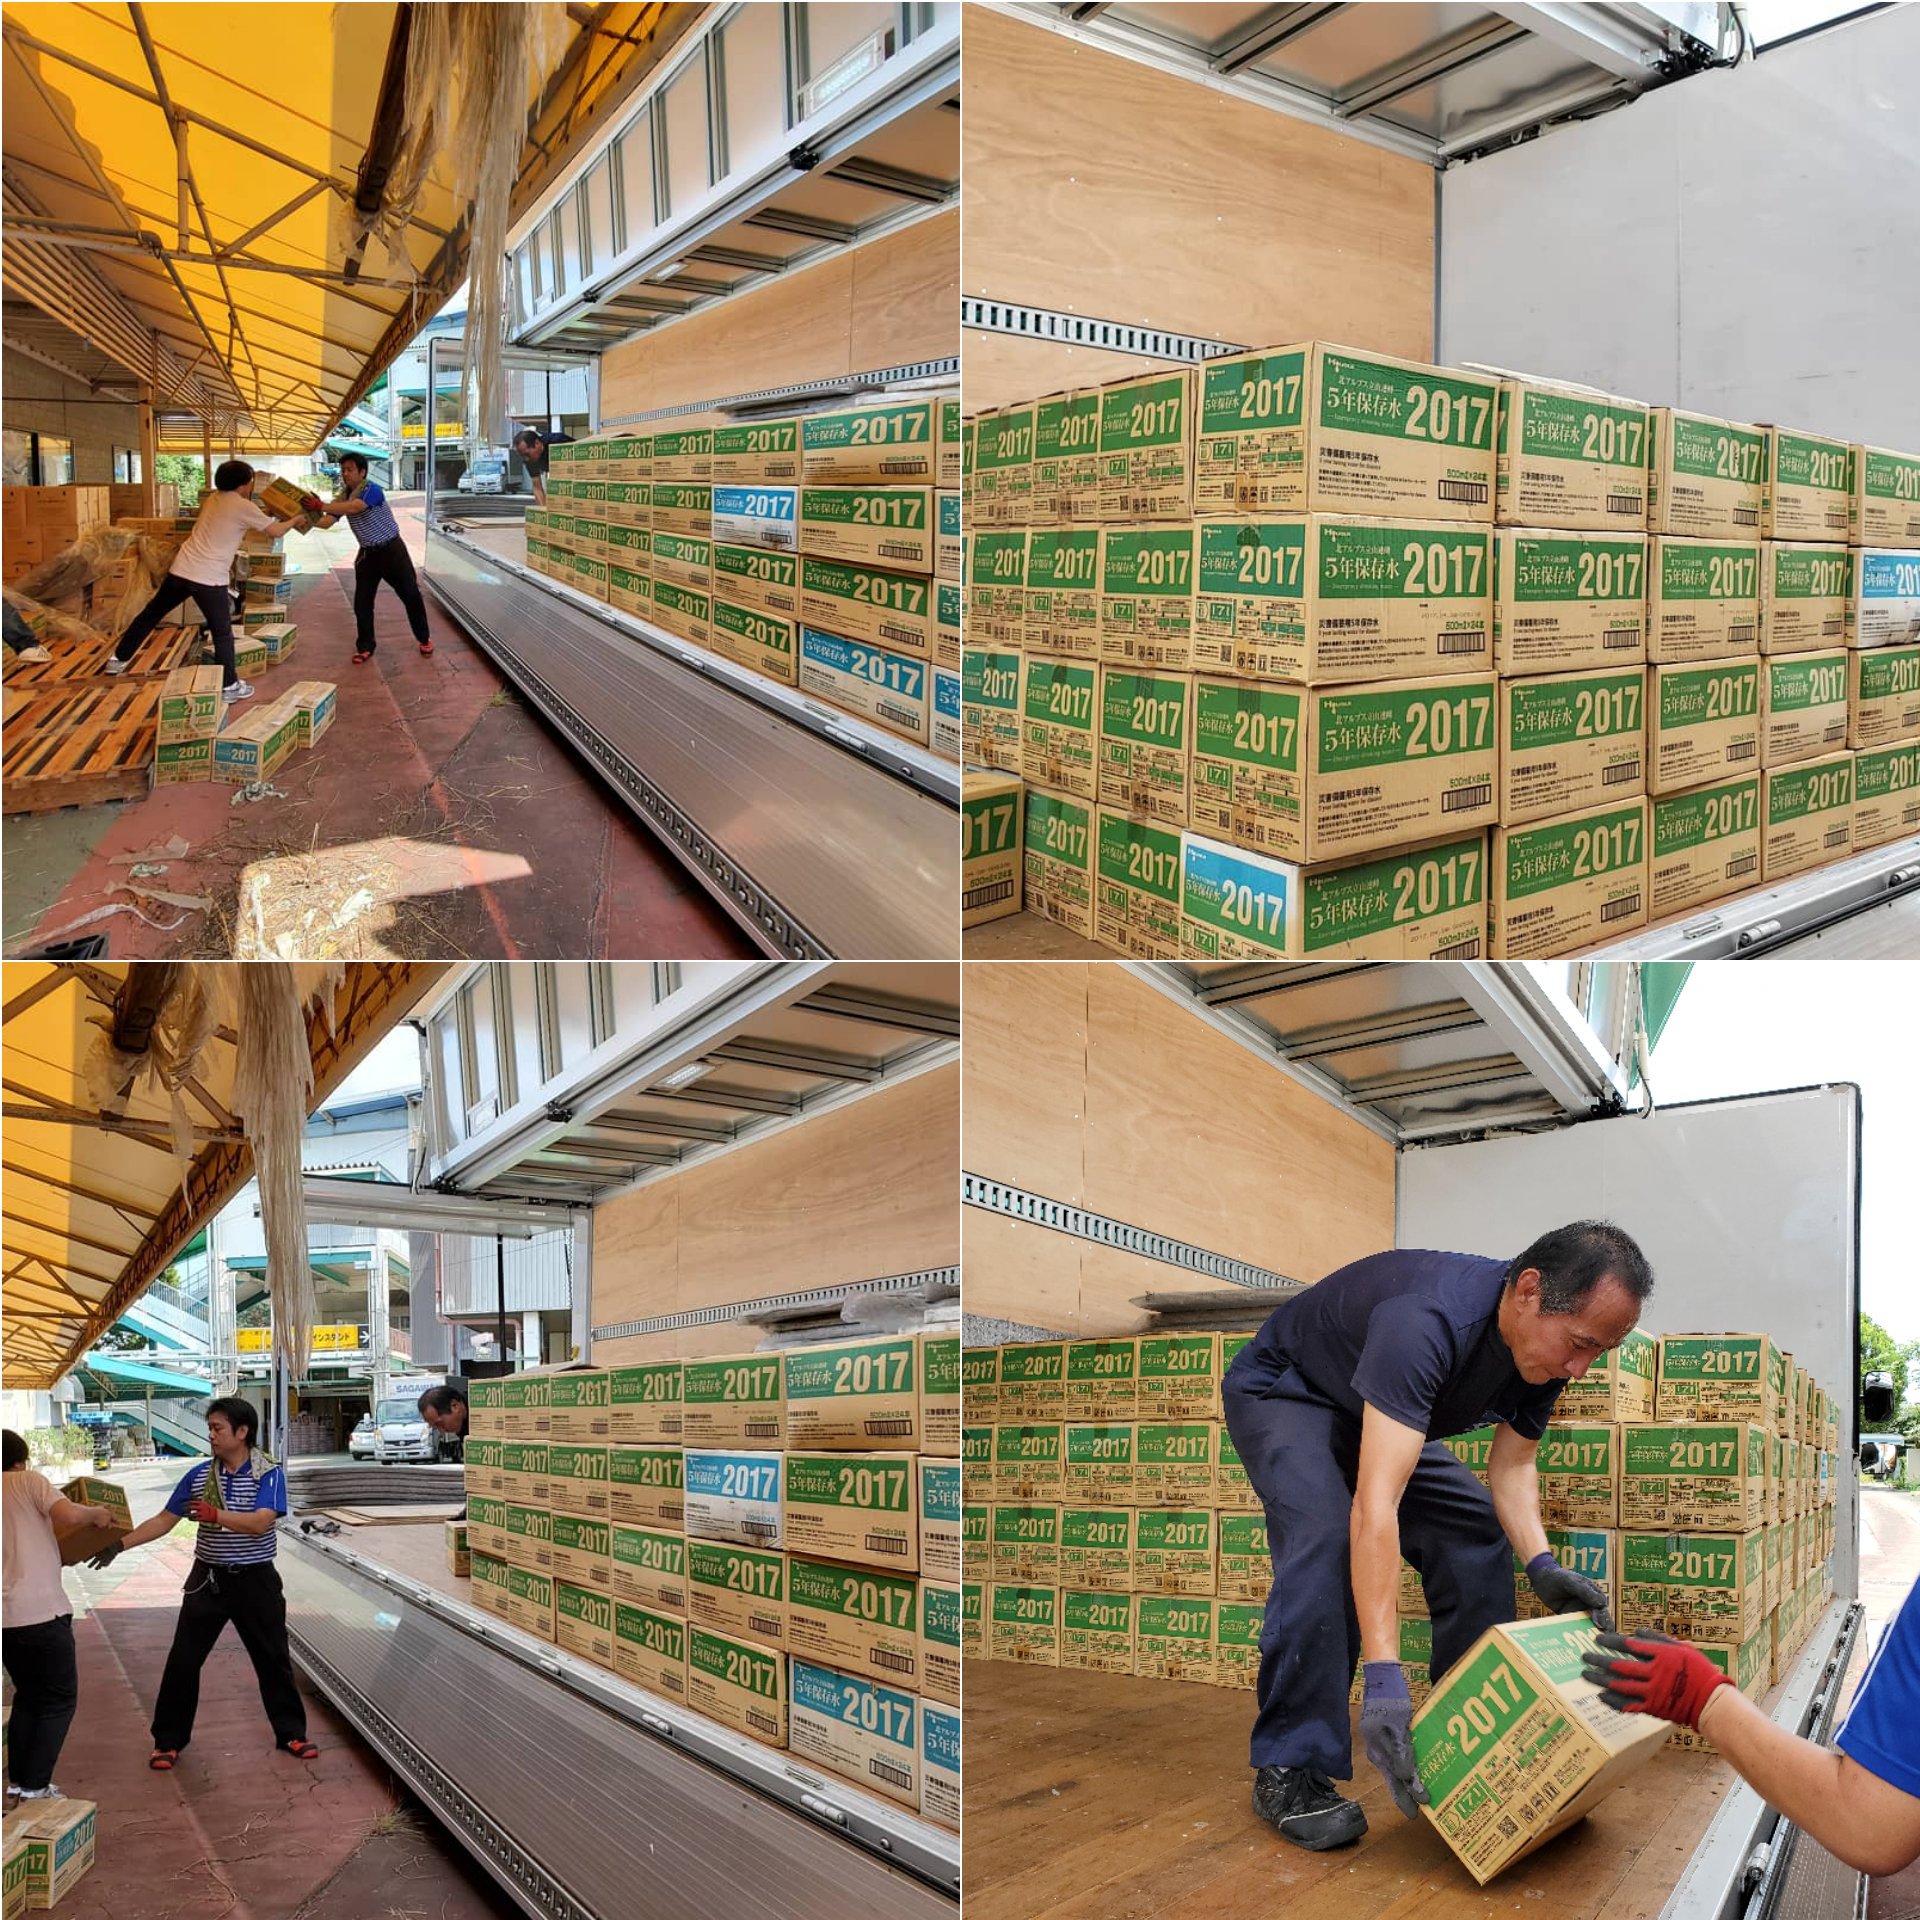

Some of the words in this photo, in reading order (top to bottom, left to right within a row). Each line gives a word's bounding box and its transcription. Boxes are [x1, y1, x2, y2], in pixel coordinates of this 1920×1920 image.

[1240, 375, 1300, 418] 2017
[1327, 387, 1401, 419] 5年保存水
[851, 412, 926, 444] 2017
[1130, 398, 1179, 437] 2017
[1404, 385, 1489, 445] 2017
[679, 435, 712, 453] 2017
[747, 428, 794, 451] 2017
[998, 428, 1031, 458] 2017
[1060, 414, 1098, 446] 2017
[1527, 420, 1580, 443] 5年保存水
[1583, 413, 1642, 463] 2017
[1717, 437, 1761, 482] 2017
[1810, 450, 1845, 488] 2017
[587, 486, 605, 499] 2017
[625, 488, 649, 503] 2017
[677, 490, 710, 508] 2017
[745, 494, 791, 518] 2017
[853, 497, 921, 527] 2017
[588, 521, 605, 536] 2017
[627, 529, 649, 550] 2017
[676, 542, 708, 564] 2017
[1054, 548, 1096, 579] 2017
[1137, 550, 1190, 584] 2017
[1239, 546, 1302, 585] 2017
[588, 561, 605, 580] 2017
[747, 556, 794, 584] 2017
[1325, 557, 1399, 579] 5年保存水
[1403, 543, 1484, 595] 2017
[1520, 565, 1575, 585] 5年保存水
[1578, 552, 1641, 597] 2017
[1710, 556, 1754, 596] 2017
[1810, 560, 1844, 594] 2017
[627, 573, 649, 595] 2017
[853, 574, 924, 613] 2017
[677, 593, 708, 619] 2017
[744, 617, 789, 649] 2017
[240, 650, 264, 664] 2017
[851, 649, 920, 695] 2017
[983, 668, 1016, 700] 2017
[1809, 665, 1845, 703] 2017
[1891, 658, 1919, 692] 2017
[1050, 682, 1091, 719] 2017
[1576, 685, 1639, 736] 2017
[1706, 675, 1755, 717] 2017
[1132, 696, 1182, 737] 2017
[1405, 696, 1490, 755] 2017
[1515, 707, 1572, 732] 5年保存水
[1234, 710, 1295, 758] 2017
[1325, 722, 1401, 751] 5年保存水
[179, 743, 208, 758] 2017
[231, 749, 257, 762] 2017
[1209, 766, 1227, 782] 171
[1807, 770, 1849, 811] 2017
[1704, 788, 1756, 839] 2017
[1046, 816, 1086, 857] 2017
[1573, 818, 1639, 877] 2017
[1129, 843, 1177, 890] 2017
[1512, 850, 1570, 881] 5年保存水
[1393, 851, 1478, 922] 2017
[1220, 880, 1282, 936] 2017
[1310, 890, 1388, 929] 5年保存水
[1195, 931, 1213, 948] 171
[835, 1352, 908, 1392] 2017
[963, 1360, 995, 1379] 2017
[1025, 1356, 1062, 1376] 2017
[1094, 1353, 1132, 1373] 2017
[1168, 1349, 1210, 1370] 2017
[1702, 1352, 1757, 1372] 2017
[524, 1384, 549, 1405] 2017
[577, 1381, 609, 1405] 2017
[643, 1372, 682, 1400] 2017
[723, 1366, 776, 1400] 2017
[522, 1450, 548, 1472] 2017
[1021, 1437, 1057, 1456] 2017
[1092, 1438, 1129, 1457] 2017
[1166, 1437, 1208, 1457] 2017
[1549, 1442, 1606, 1467] 2017
[1670, 1442, 1734, 1467] 2017
[574, 1453, 606, 1477] 2017
[641, 1457, 682, 1484] 2017
[721, 1464, 776, 1498] 2017
[839, 1468, 906, 1508] 2017
[484, 1506, 504, 1527] 2017
[526, 1514, 549, 1538] 2017
[1019, 1518, 1055, 1537] 2017
[578, 1526, 609, 1553] 2017
[1087, 1523, 1127, 1543] 2017
[1165, 1523, 1207, 1545] 2017
[642, 1540, 682, 1571] 2017
[1668, 1552, 1733, 1580] 2017
[488, 1564, 507, 1586] 2017
[727, 1557, 780, 1598] 2017
[527, 1578, 550, 1606] 2017
[843, 1578, 912, 1626] 2017
[581, 1597, 609, 1627] 2017
[1017, 1598, 1053, 1619] 2017
[1089, 1605, 1128, 1626] 2017
[1167, 1611, 1209, 1634] 2017
[645, 1621, 681, 1657] 2017
[727, 1650, 775, 1695] 2017
[843, 1687, 910, 1741] 2017
[1447, 1662, 1523, 1754] 2017
